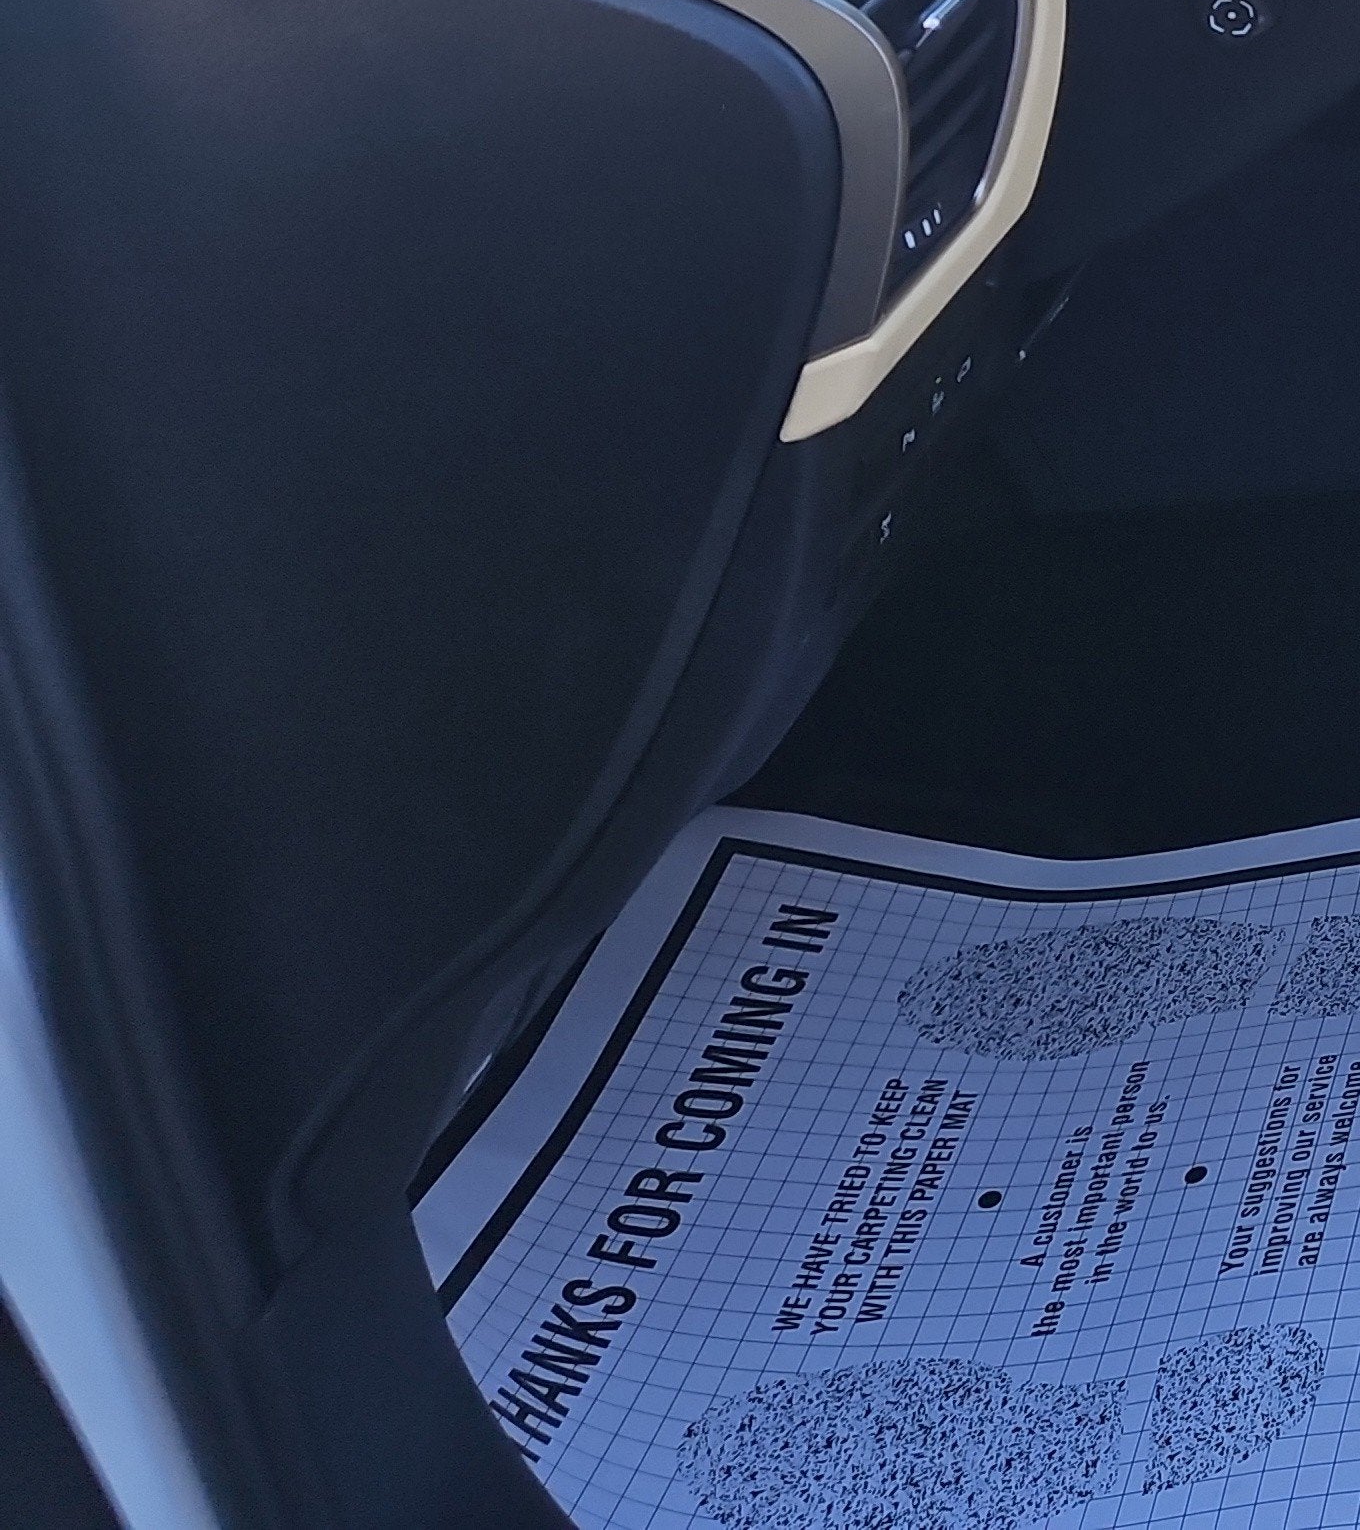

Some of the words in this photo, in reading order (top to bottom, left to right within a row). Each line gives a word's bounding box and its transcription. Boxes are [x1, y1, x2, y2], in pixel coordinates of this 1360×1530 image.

[868, 1078, 909, 1126] KEEP
[1145, 1094, 1171, 1125] us.
[1302, 1054, 1337, 1124] service
[853, 1133, 887, 1159] TO
[1066, 1125, 1093, 1144] is
[1131, 1130, 1158, 1158] to
[1292, 1129, 1316, 1162] our
[488, 1278, 637, 1464] HANKS
[586, 1169, 705, 1269] FOR
[655, 965, 810, 1152] COMING
[762, 904, 839, 954] IN
[821, 1165, 872, 1227] TRIED
[1031, 1301, 1066, 1337] the
[1051, 1237, 1088, 1292] most
[1074, 1131, 1125, 1232] important
[1111, 1060, 1151, 1127] person
[1033, 1150, 1084, 1246] customer
[1113, 1157, 1150, 1216] world
[1219, 1225, 1255, 1276] Your
[1240, 1097, 1292, 1219] suggestions
[1274, 1066, 1301, 1092] for
[1307, 1152, 1346, 1224] always
[810, 1273, 862, 1336] YOUR
[843, 1147, 918, 1265] CARPETING
[900, 1078, 949, 1141] CLEAN
[855, 1265, 904, 1324] WITH
[884, 1209, 928, 1259] THIS
[909, 1137, 960, 1201] PAPER
[940, 1089, 979, 1130] MAT
[1253, 1168, 1311, 1277] improving
[792, 1232, 841, 1290] HAVE
[1020, 1253, 1047, 1268] A
[1096, 1221, 1127, 1257] the
[1300, 1232, 1324, 1267] are
[1084, 1262, 1115, 1285] in
[772, 1296, 812, 1331] WE
